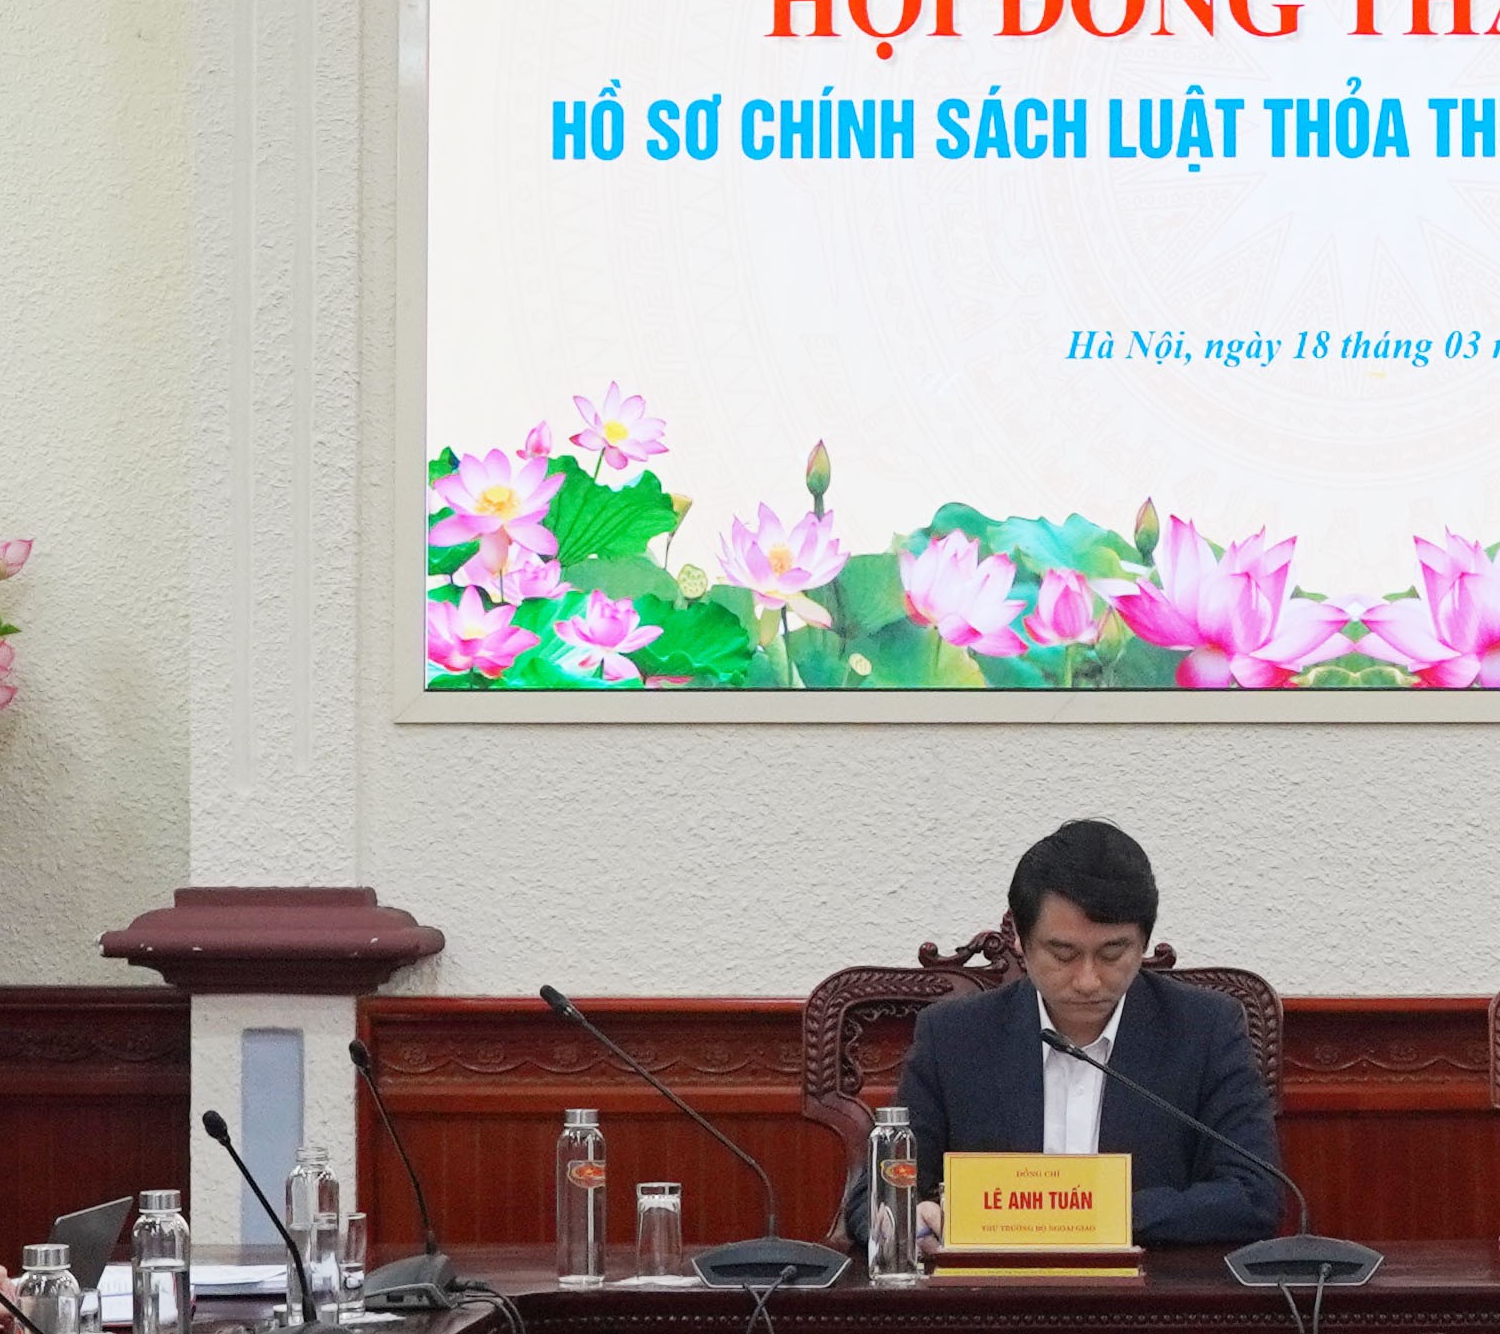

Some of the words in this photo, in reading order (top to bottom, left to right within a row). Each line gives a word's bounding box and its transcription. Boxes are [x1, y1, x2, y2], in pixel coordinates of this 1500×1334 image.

[551, 78, 625, 161] HỒ
[645, 92, 723, 162] SƠ
[740, 84, 915, 161] CHÍNH
[935, 84, 1088, 161] SÁCH
[1108, 83, 1246, 174] LUẬT
[1262, 75, 1411, 160] THỎA
[1066, 330, 1115, 360] Hà
[1125, 330, 1193, 365] Nội,
[1203, 331, 1283, 368] ngày
[1295, 330, 1332, 360] 18
[1340, 330, 1433, 368] tháng
[1444, 330, 1482, 360] 03
[983, 1187, 1003, 1210] LÊ
[1008, 1191, 1043, 1210] ANH
[1048, 1184, 1093, 1210] TUẤN
